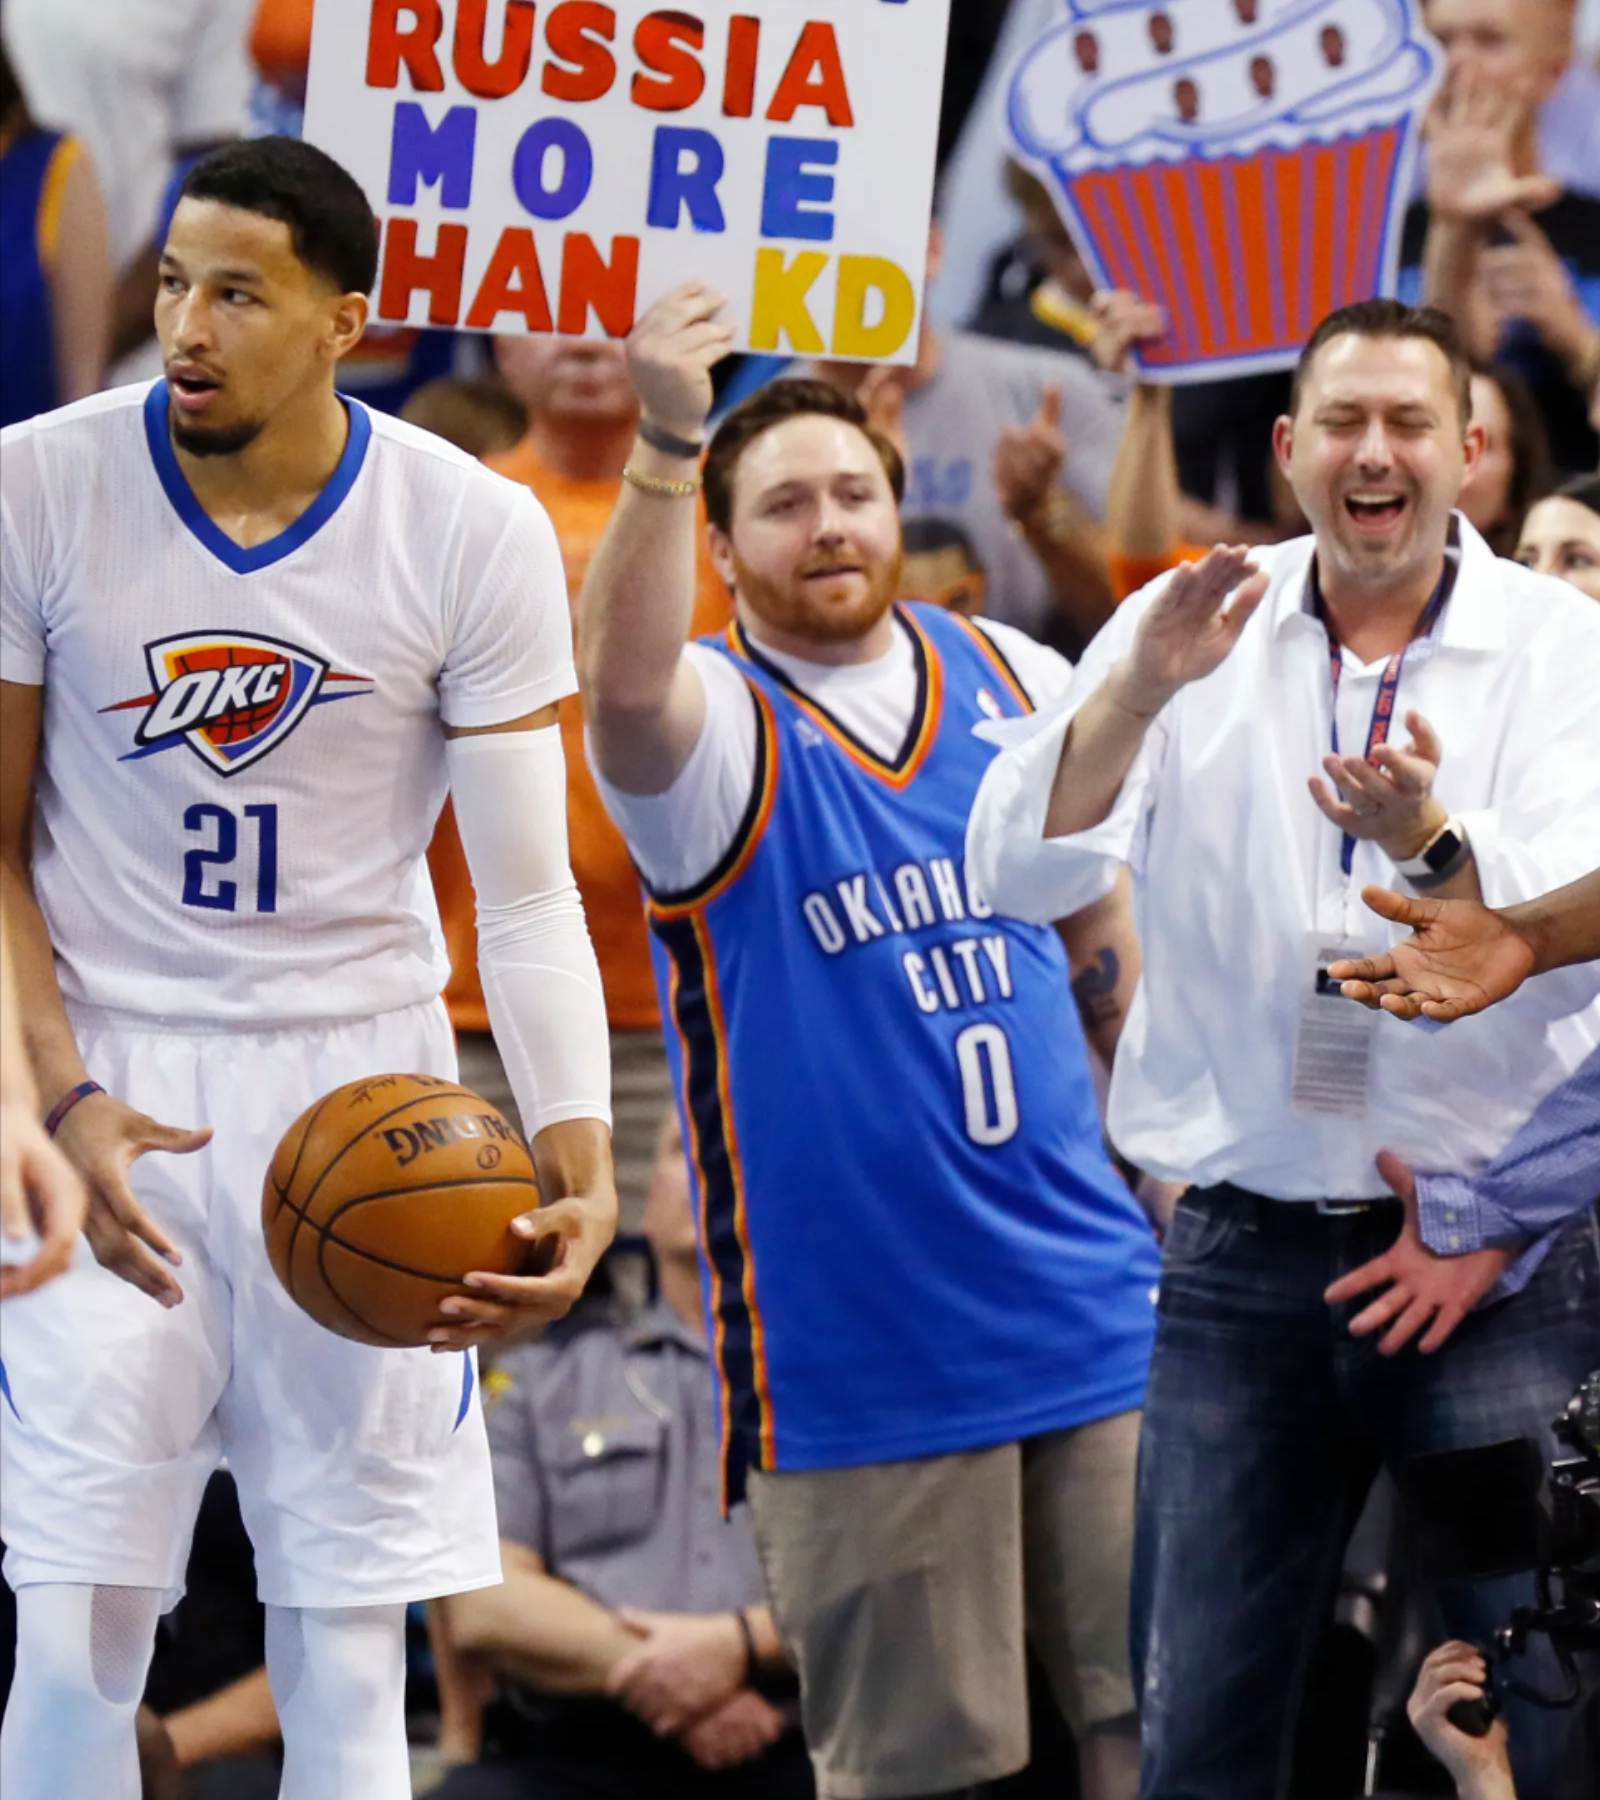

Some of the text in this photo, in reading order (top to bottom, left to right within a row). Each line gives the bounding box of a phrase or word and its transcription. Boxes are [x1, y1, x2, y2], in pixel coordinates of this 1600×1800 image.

[366, 0, 854, 127] RUSSIA
[387, 101, 839, 241] MORE
[373, 217, 915, 358] HAN KD
[142, 662, 287, 741] OKC
[182, 803, 278, 913] 21
[803, 858, 993, 954] OKLAH
[903, 936, 1012, 1013] CITY
[955, 1022, 1019, 1146] 0
